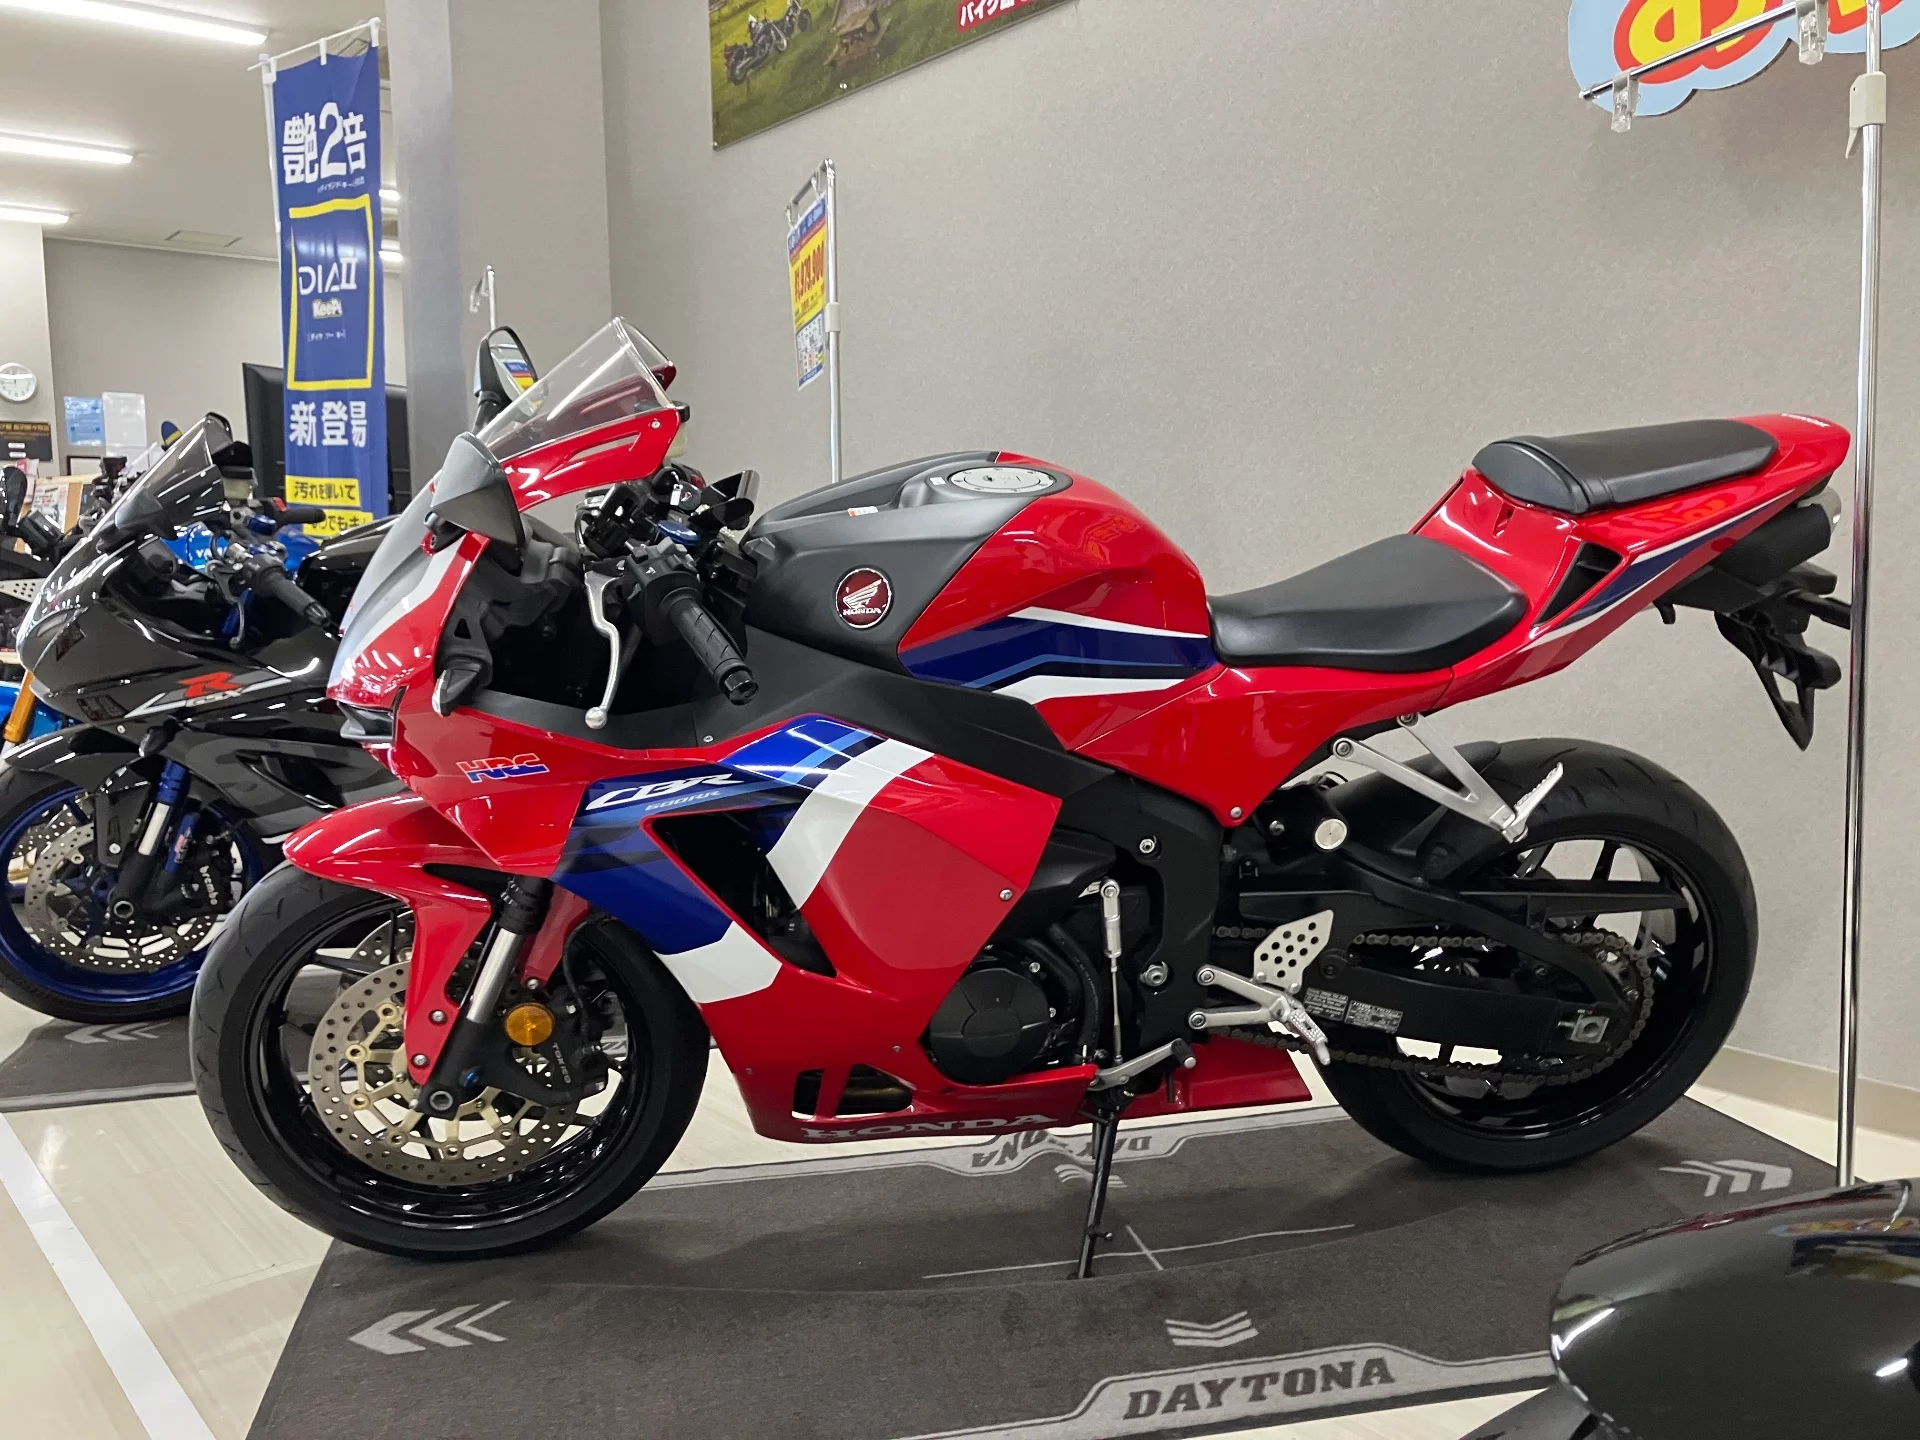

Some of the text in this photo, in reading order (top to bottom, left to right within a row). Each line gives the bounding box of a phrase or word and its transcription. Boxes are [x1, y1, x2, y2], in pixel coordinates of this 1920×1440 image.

[289, 400, 367, 448] 新登場
[842, 607, 882, 616] HONDA
[456, 752, 550, 784] HRC
[585, 773, 745, 811] CBR
[645, 790, 721, 811] 600RR
[199, 865, 219, 905] brembo
[552, 1042, 571, 1084] TOKICO
[800, 1114, 1058, 1140] HONDA
[1122, 1357, 1396, 1420] DAYTONA
